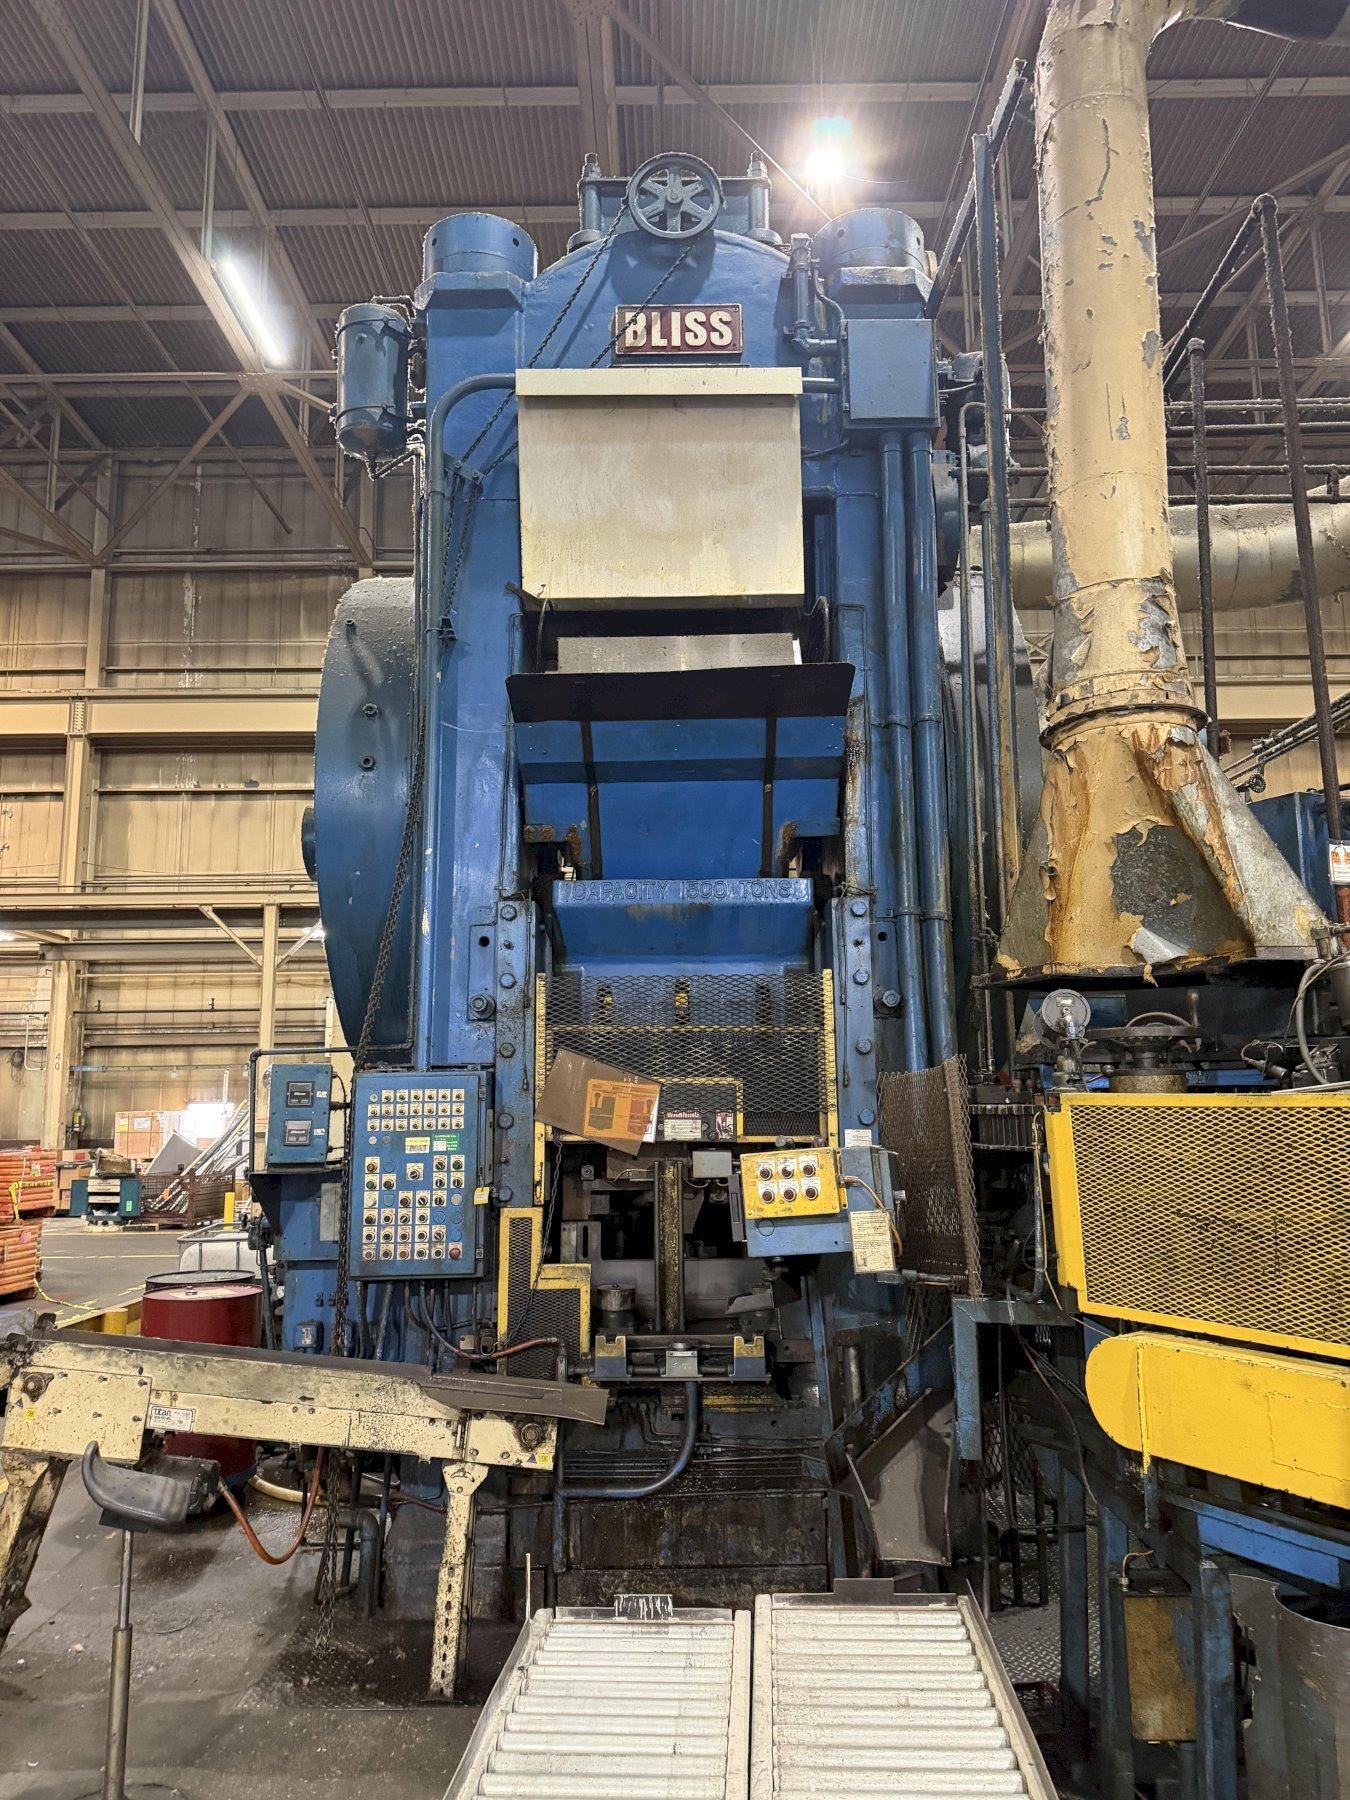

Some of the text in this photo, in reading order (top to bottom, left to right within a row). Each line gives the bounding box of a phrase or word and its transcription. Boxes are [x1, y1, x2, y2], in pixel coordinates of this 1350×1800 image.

[625, 311, 733, 347] BLISS
[572, 879, 792, 901] CAPACITY 1500 TONS
